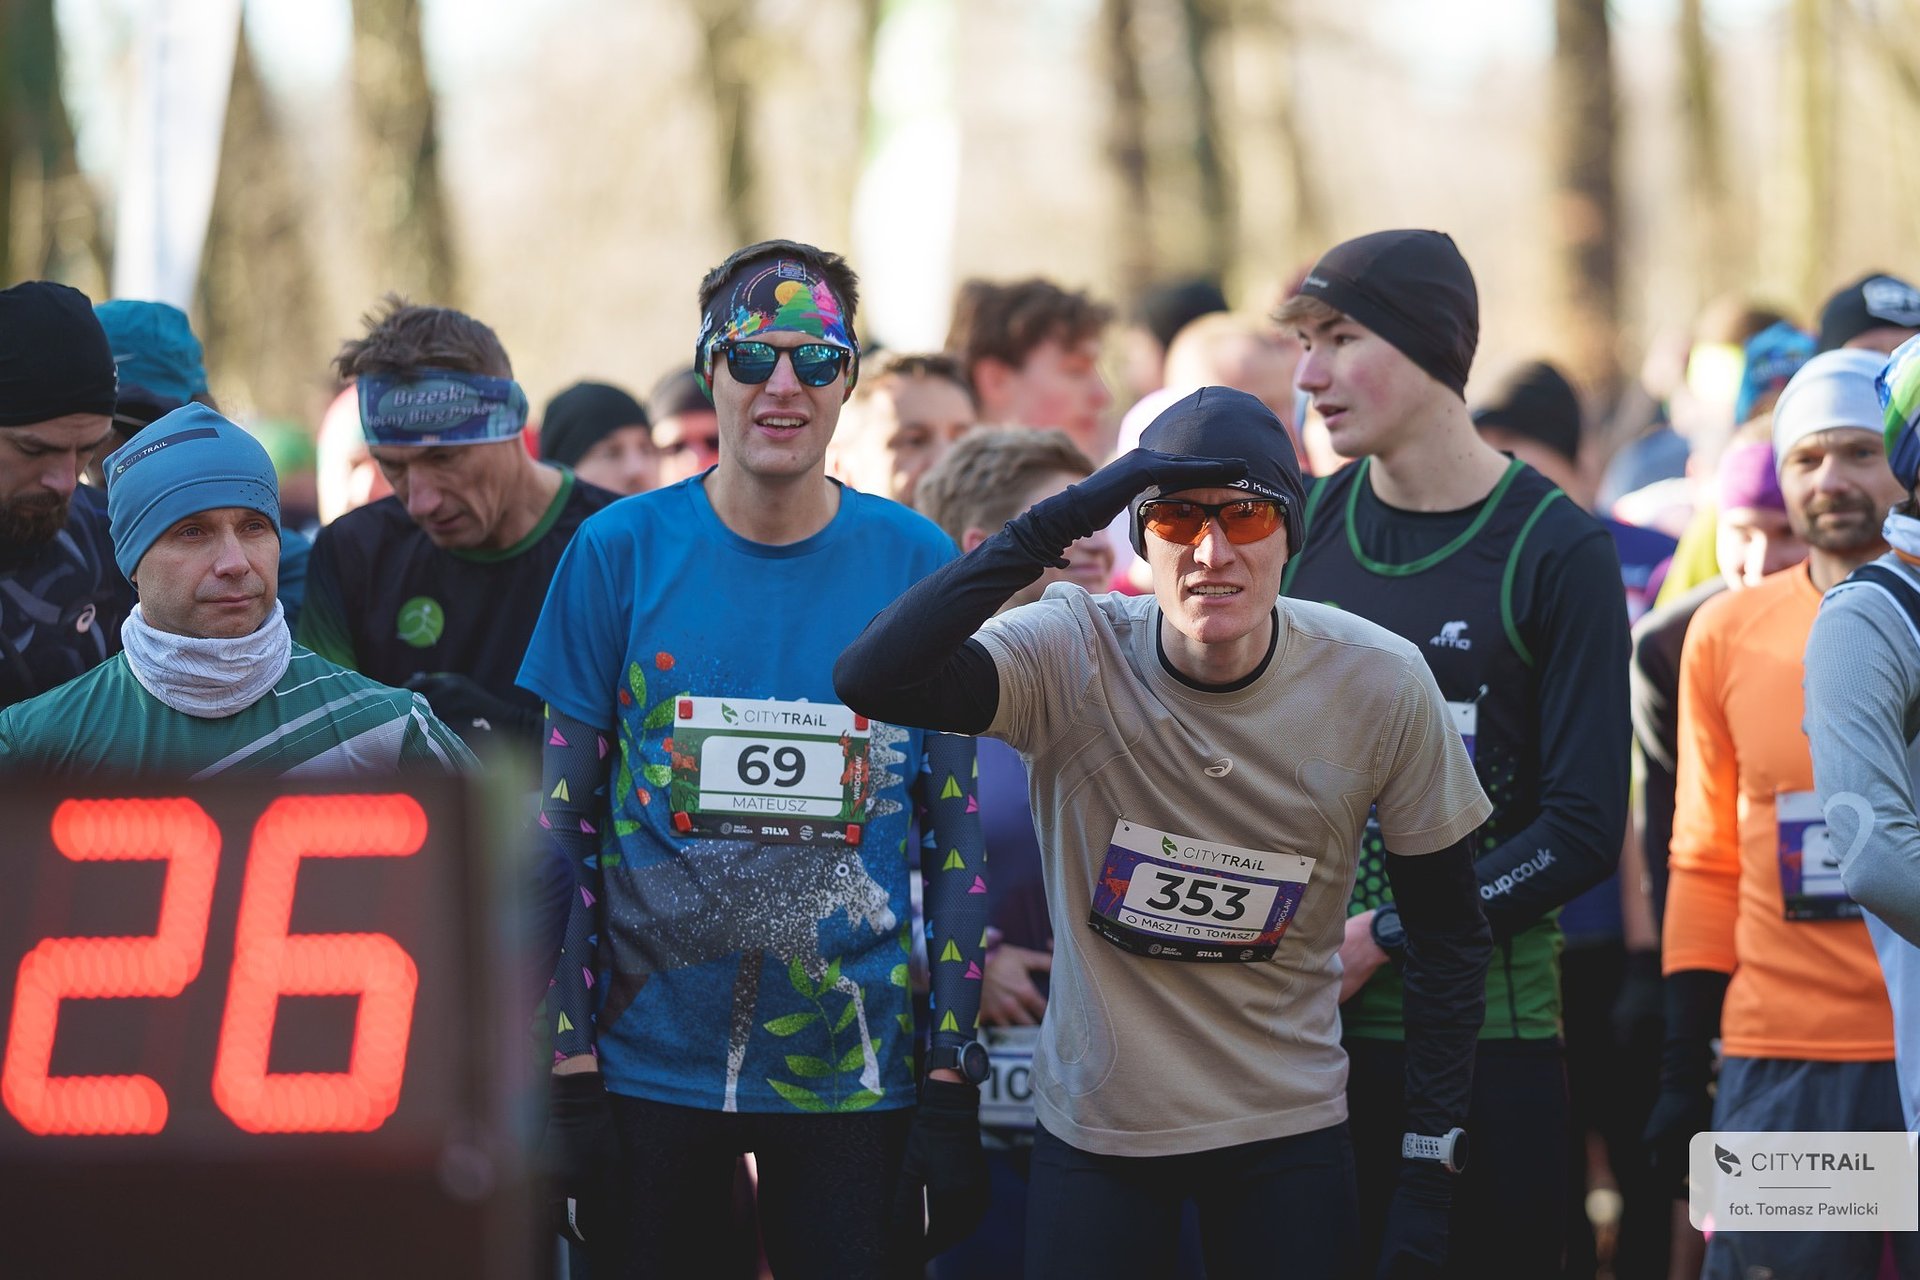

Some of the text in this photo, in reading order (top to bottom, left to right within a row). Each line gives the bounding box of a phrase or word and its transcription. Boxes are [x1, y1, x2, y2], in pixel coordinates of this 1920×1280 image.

[393, 384, 466, 407] Brzeski
[408, 409, 449, 425] Bieg
[737, 744, 807, 788] 69
[732, 796, 807, 813] MATEUSZ
[761, 826, 790, 836] SILVA
[1145, 871, 1251, 921] 353
[1126, 914, 1255, 941] O MASZ! TO TOMASZ!
[2, 794, 428, 1136] 26
[1196, 950, 1223, 959] SILVA
